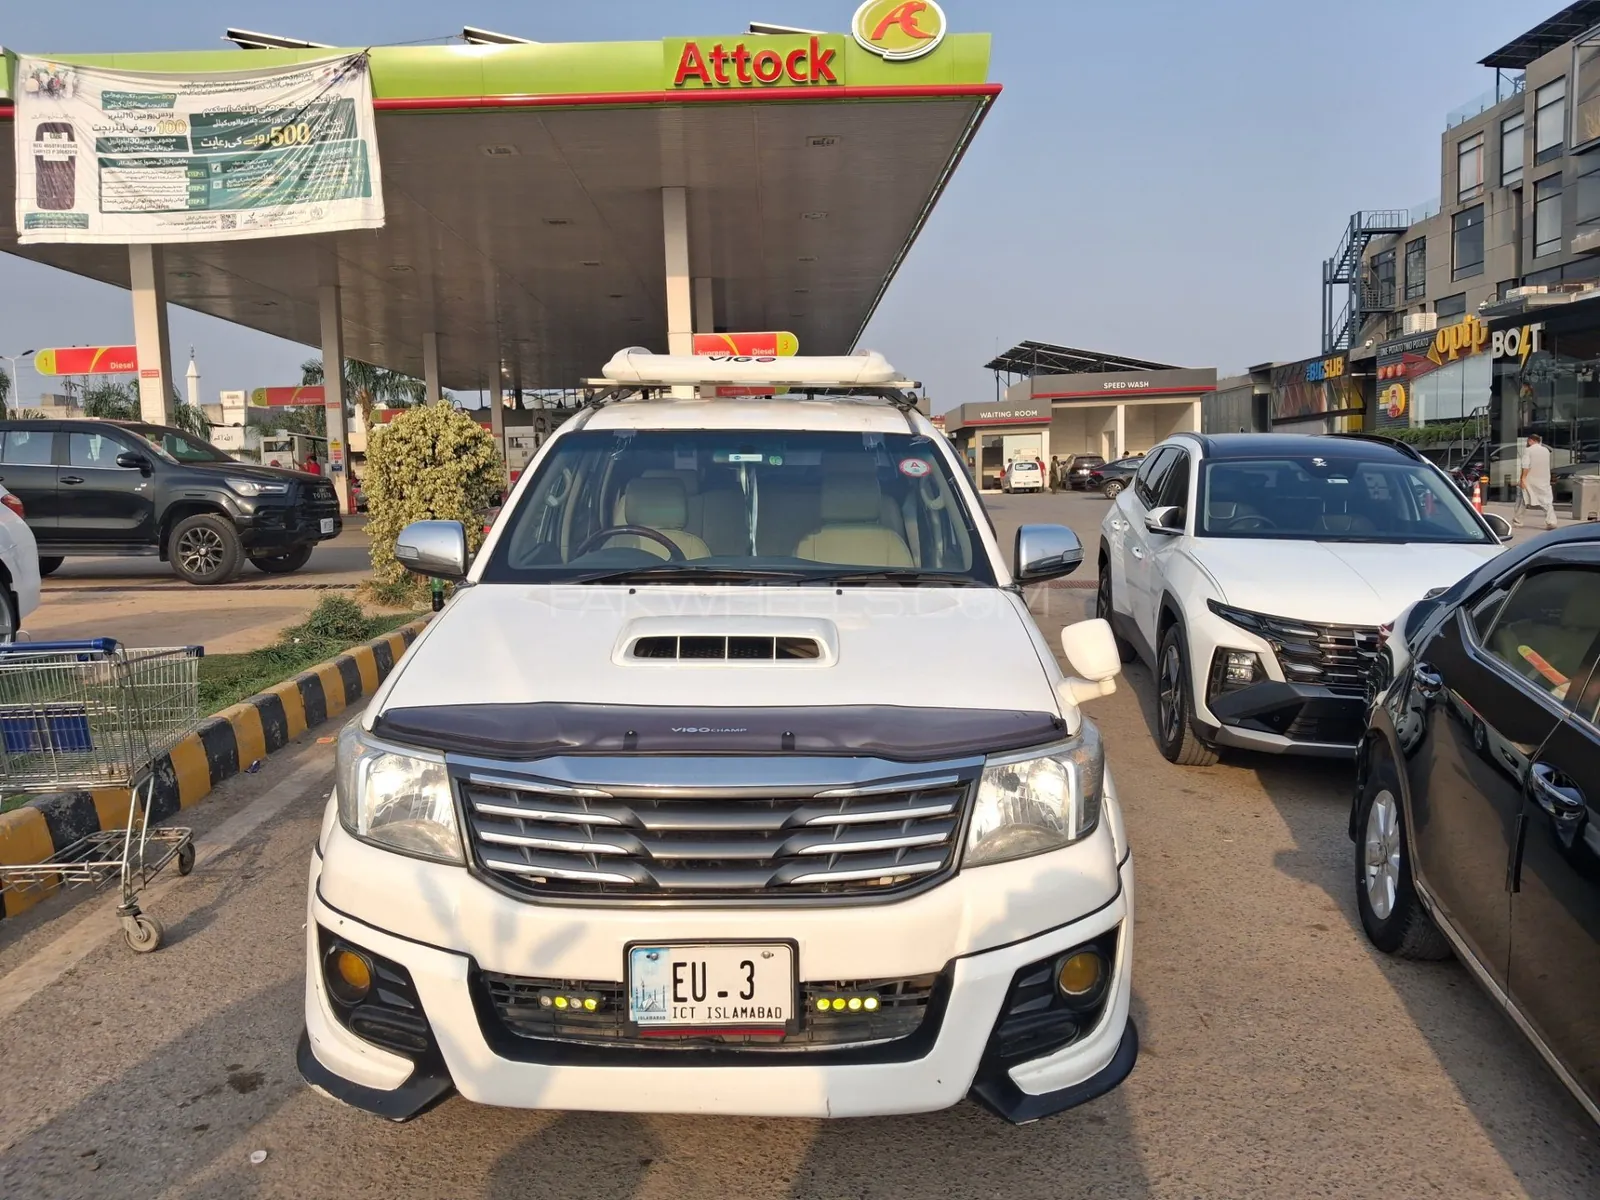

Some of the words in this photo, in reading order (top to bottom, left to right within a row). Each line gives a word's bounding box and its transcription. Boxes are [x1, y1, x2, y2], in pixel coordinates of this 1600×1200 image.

[673, 36, 836, 85] Attock
[126, 124, 139, 133] فی
[139, 126, 157, 135] روپے
[157, 119, 187, 134] 100
[243, 134, 270, 147] روپے
[271, 122, 310, 147] 500
[200, 136, 228, 149] رعایت
[228, 136, 242, 148] کی
[751, 347, 775, 356] Diesel
[783, 340, 789, 350] 3
[1388, 343, 1403, 354] POTATO
[1403, 341, 1412, 351] TWO
[1413, 337, 1429, 349] POTATO
[44, 356, 48, 367] 1
[110, 361, 134, 370] Diesel
[1127, 381, 1149, 389] WASH
[256, 391, 264, 400] 5
[980, 411, 1011, 419] WAITING
[1014, 409, 1038, 418] ROOM
[673, 961, 707, 1003] EU
[739, 960, 755, 1001] 3
[673, 1006, 696, 1019] ICT
[707, 1006, 782, 1019] ISLAMABAD
